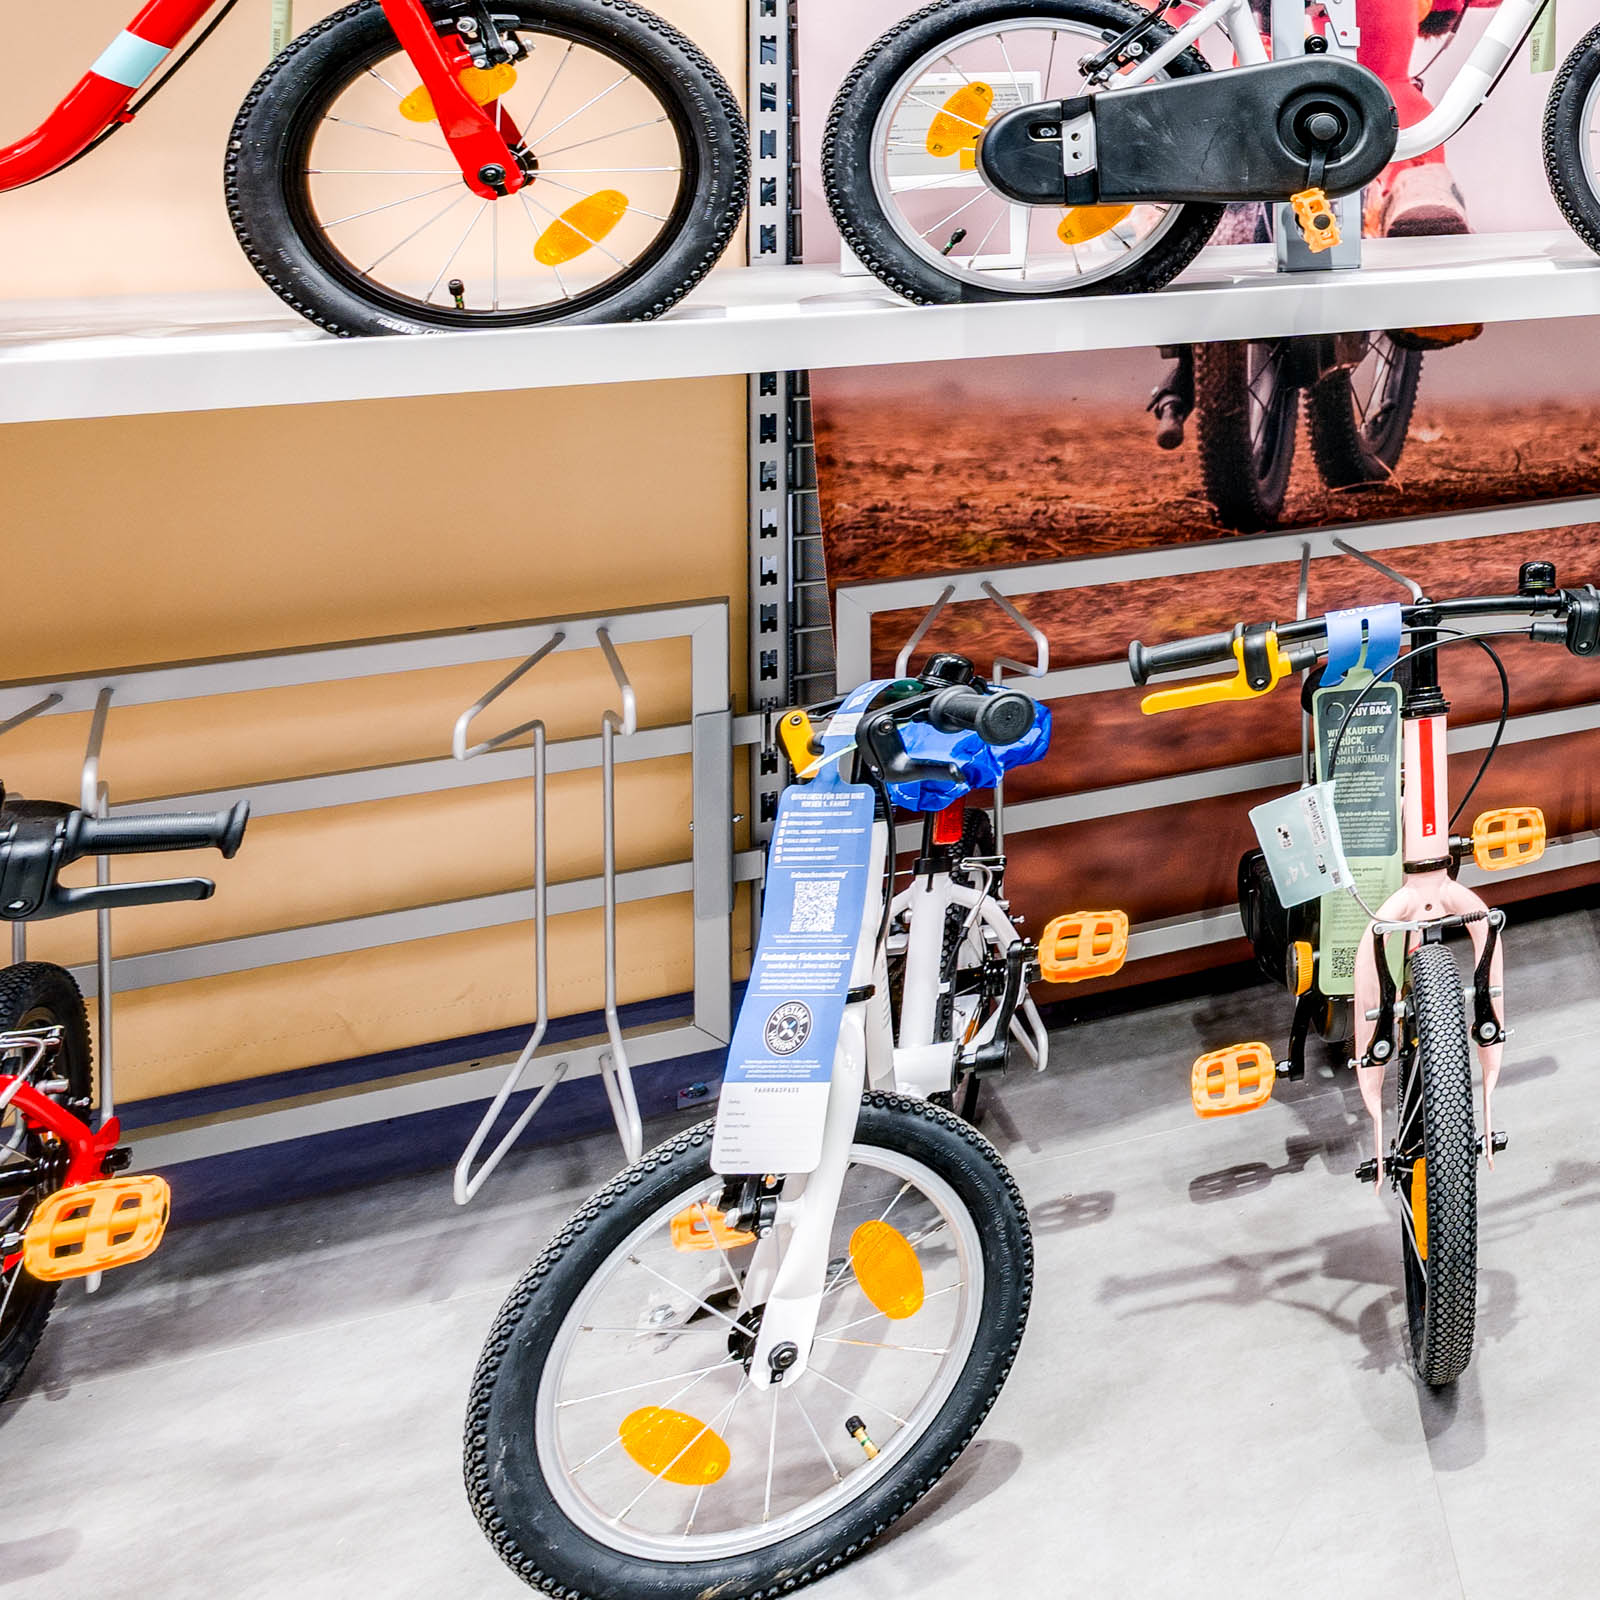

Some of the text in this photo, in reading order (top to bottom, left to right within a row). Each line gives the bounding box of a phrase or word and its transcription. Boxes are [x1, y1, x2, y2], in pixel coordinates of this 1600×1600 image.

[1370, 705, 1392, 715] BACK
[1357, 745, 1375, 754] ALLE
[1334, 754, 1390, 765] ORANKOMMEN
[772, 1006, 808, 1025] LIFETIME
[768, 1026, 805, 1050] WARRANTY
